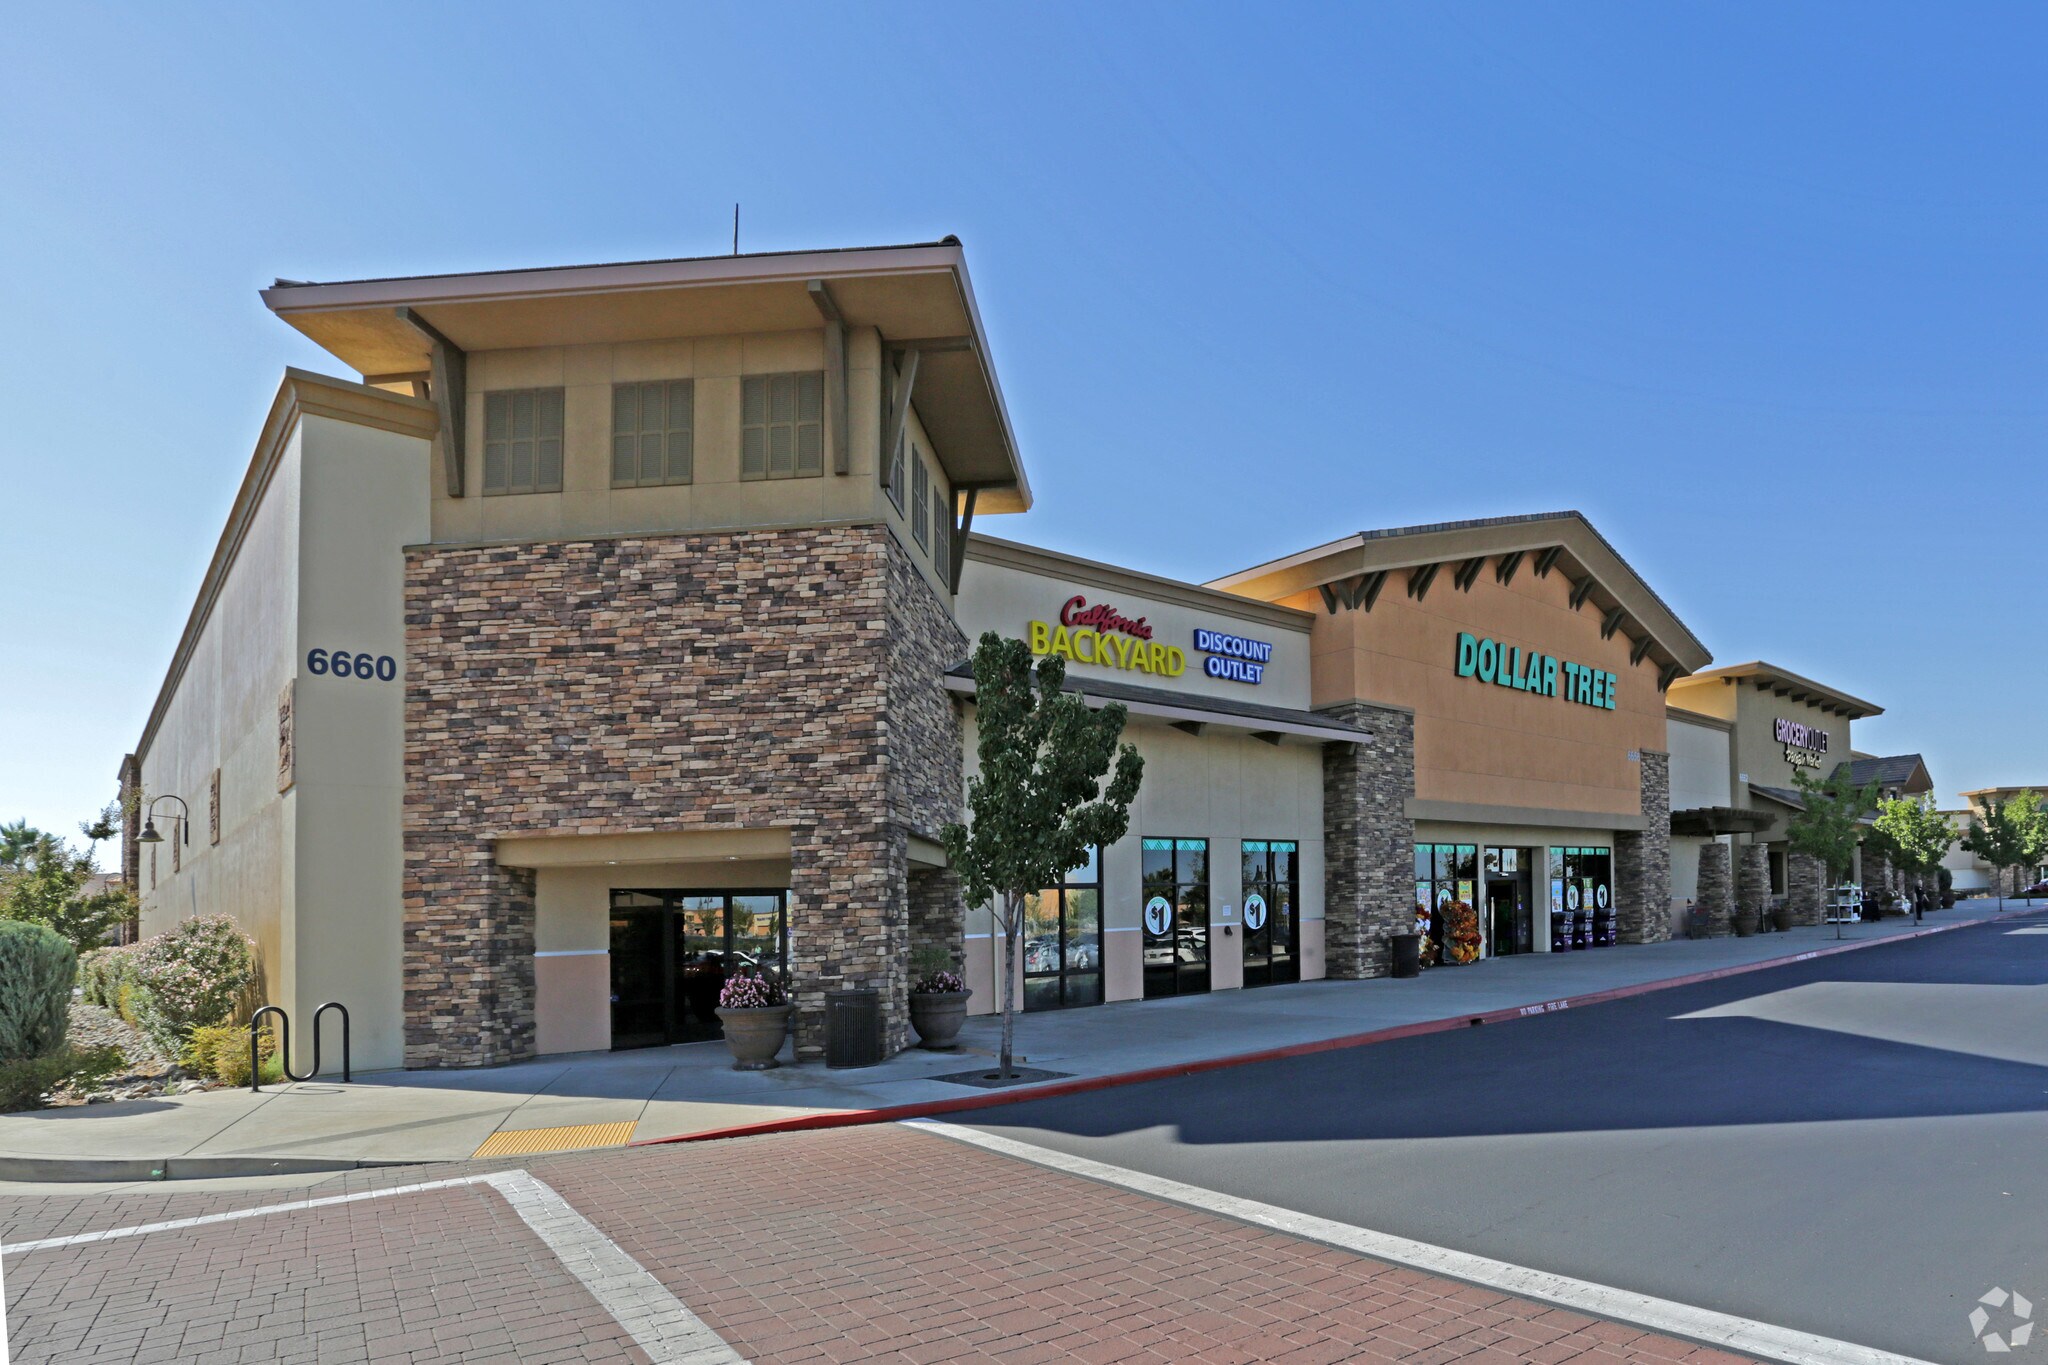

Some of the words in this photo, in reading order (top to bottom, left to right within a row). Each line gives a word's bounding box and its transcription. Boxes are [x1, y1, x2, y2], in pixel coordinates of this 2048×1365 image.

[1061, 595, 1153, 640] California
[1028, 619, 1186, 678] BACKYARD
[1194, 628, 1272, 663] DISCOUNT
[307, 648, 397, 682] 6660
[1204, 655, 1264, 685] OUTLET
[1455, 632, 1558, 697] DOLLAR
[1562, 661, 1617, 710] TREE
[1774, 717, 1808, 749] GROCERY
[1151, 904, 1165, 933] $1
[1249, 902, 1261, 928] $1
